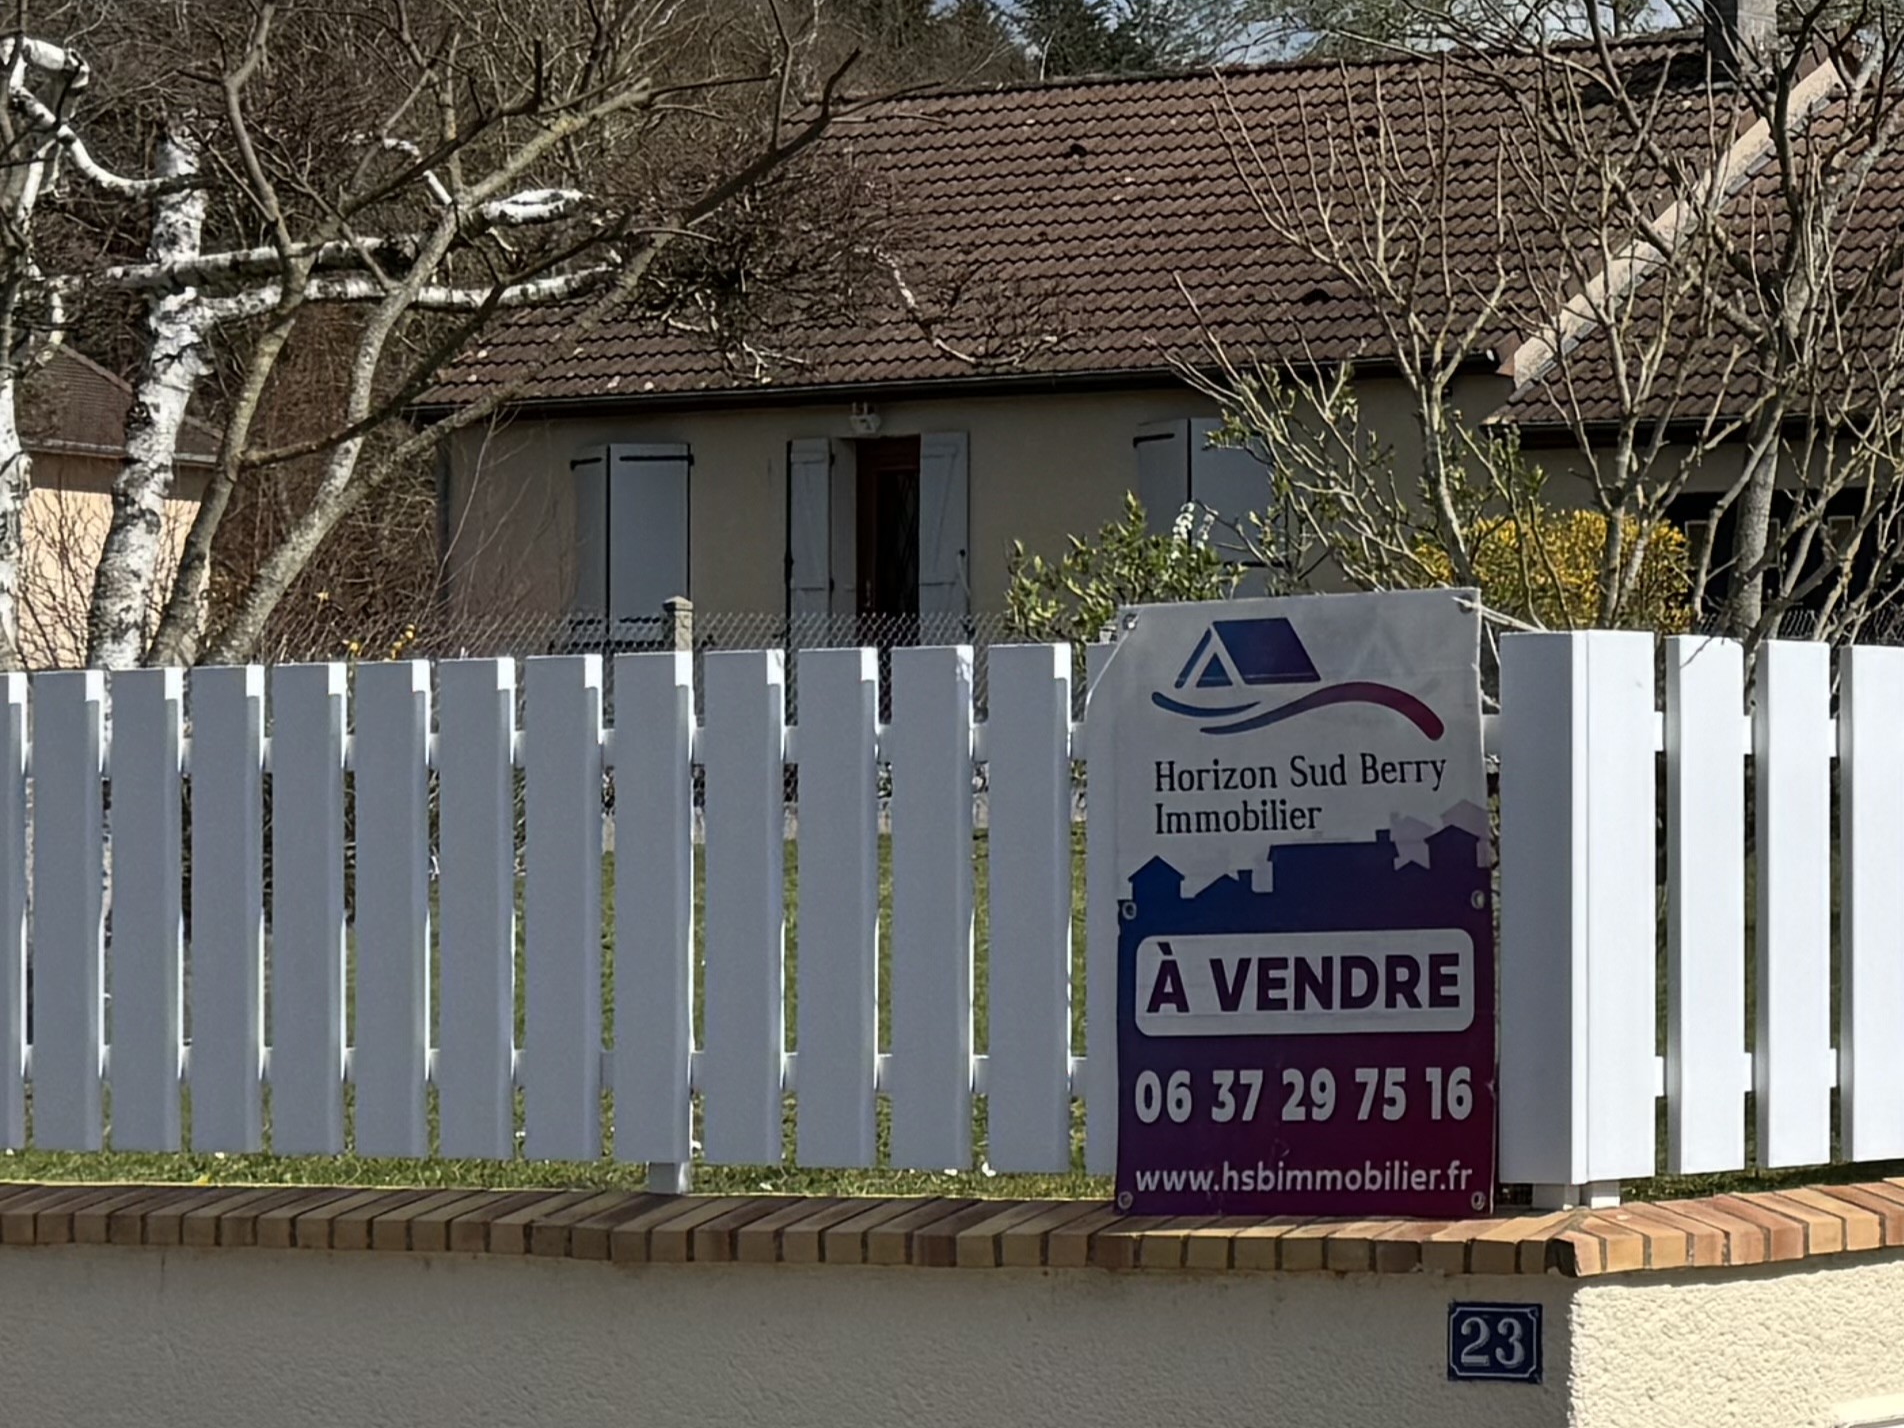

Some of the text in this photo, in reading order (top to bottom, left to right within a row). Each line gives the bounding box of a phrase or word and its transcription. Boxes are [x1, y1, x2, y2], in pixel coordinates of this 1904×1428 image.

[1154, 752, 1447, 792] Horizon Sud Berry
[1154, 798, 1323, 835] Immobilier
[1145, 941, 1460, 1014] À VENDRE
[1135, 1066, 1473, 1124] 06 37 29 75 16
[1135, 1159, 1473, 1193] www.hsbimmobilier.fr
[1460, 1316, 1526, 1368] 23
